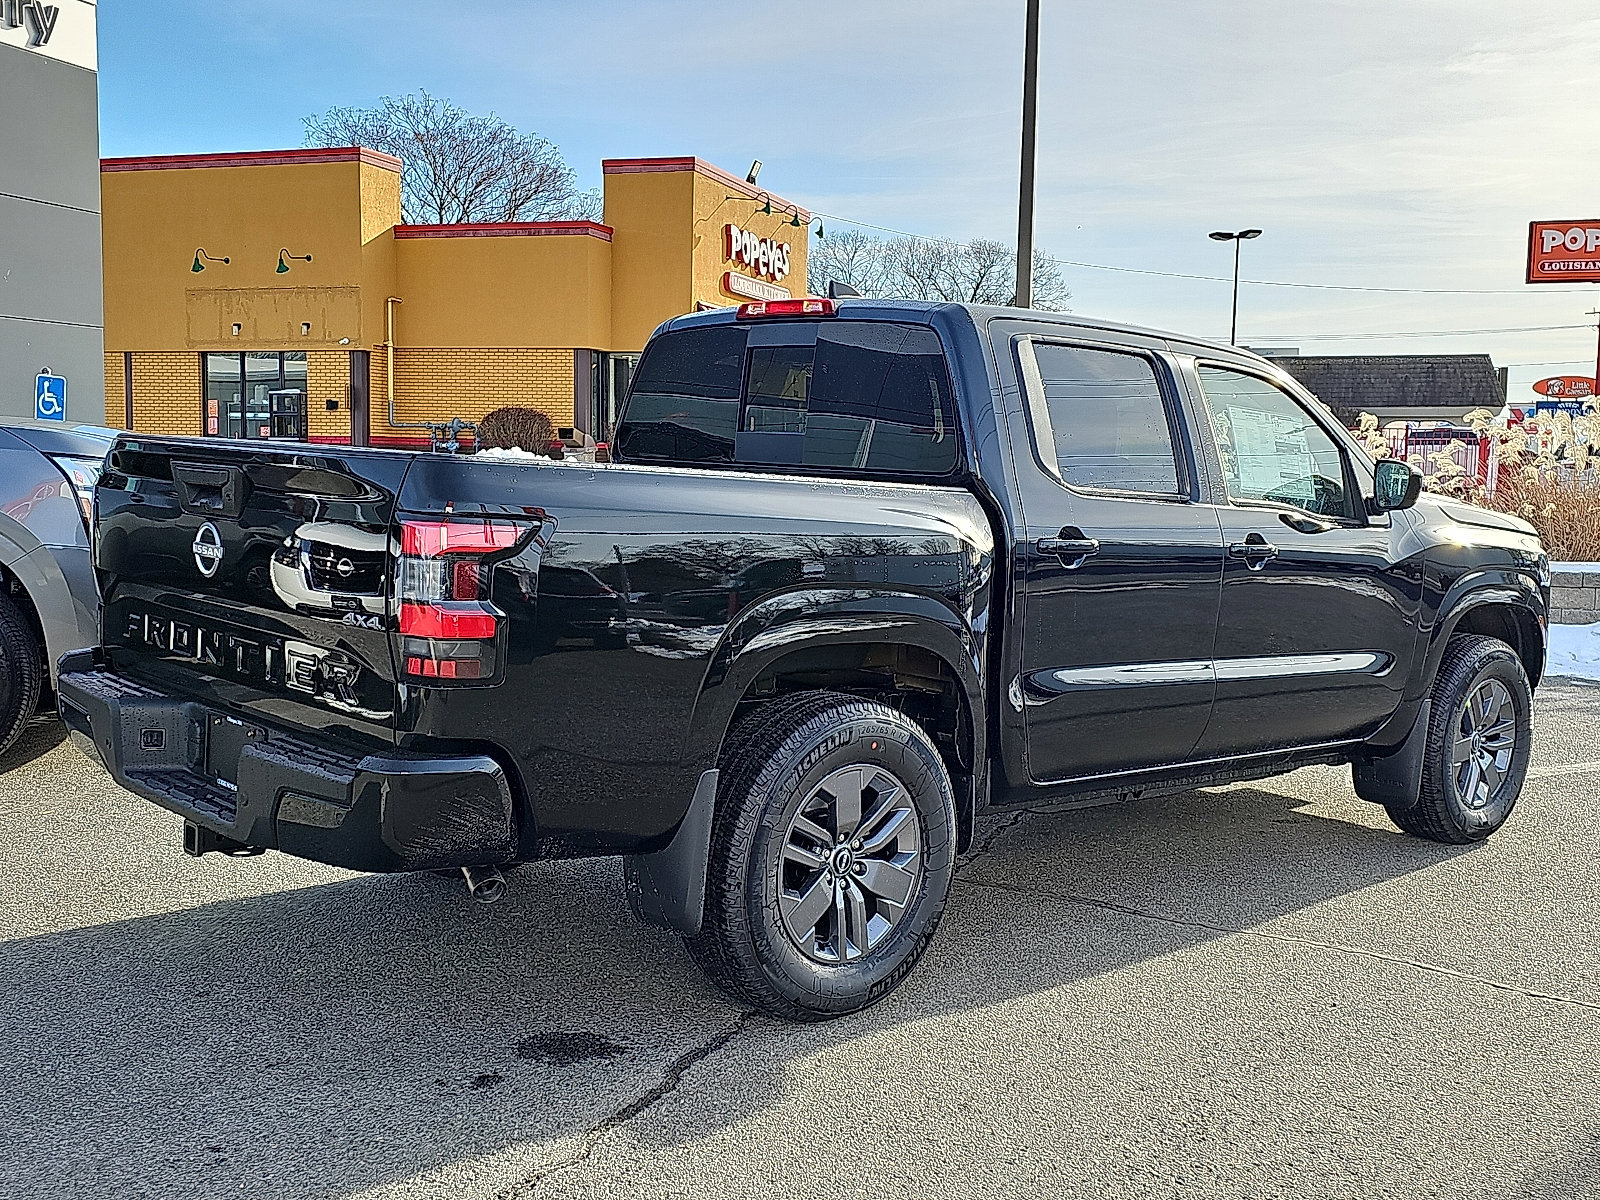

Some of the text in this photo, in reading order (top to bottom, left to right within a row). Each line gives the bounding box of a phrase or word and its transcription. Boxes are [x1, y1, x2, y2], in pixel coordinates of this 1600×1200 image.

[342, 612, 382, 631] 4X4
[122, 612, 361, 706] FRONTIER
[784, 728, 853, 793] MICHELIN
